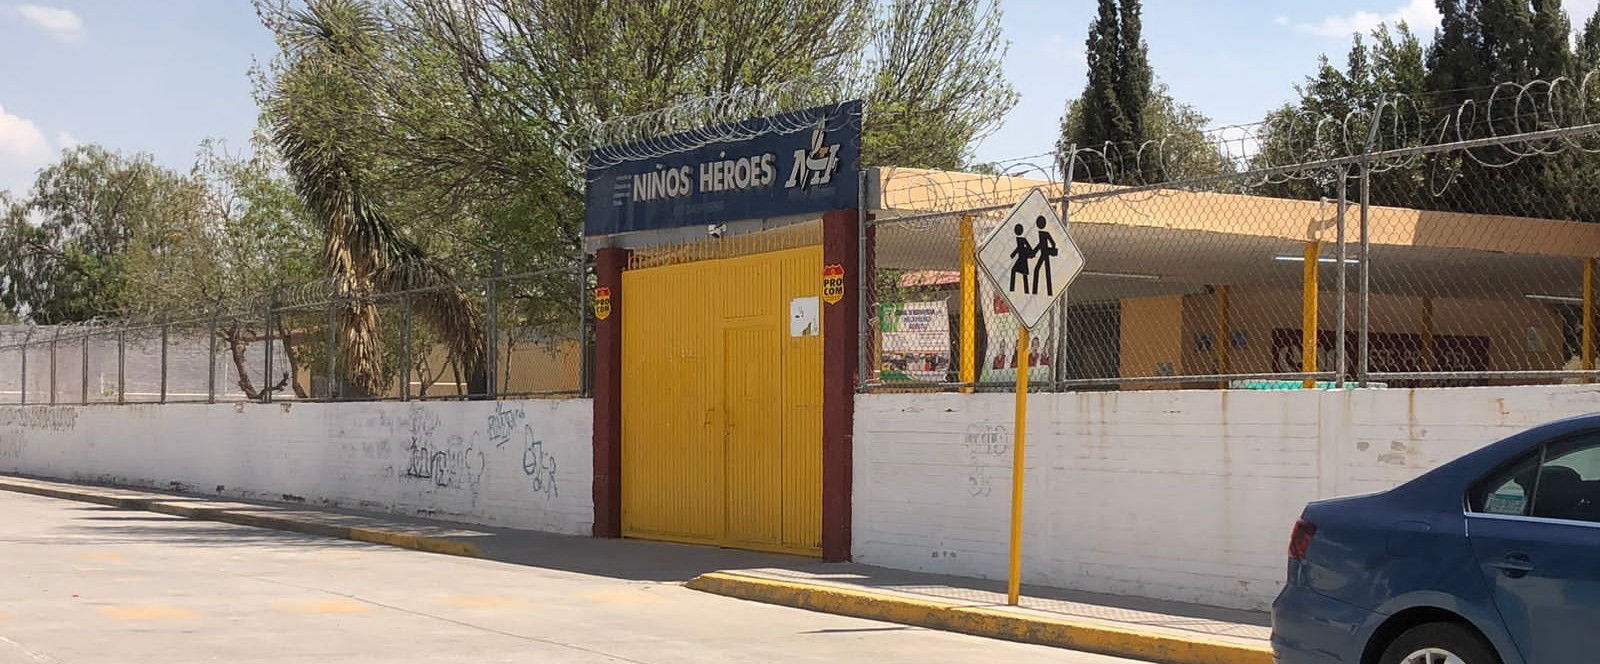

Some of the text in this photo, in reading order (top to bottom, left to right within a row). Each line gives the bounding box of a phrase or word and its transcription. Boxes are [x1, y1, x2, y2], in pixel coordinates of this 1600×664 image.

[632, 164, 691, 202] NIÑOS
[823, 277, 843, 288] PRO
[823, 286, 843, 296] COM
